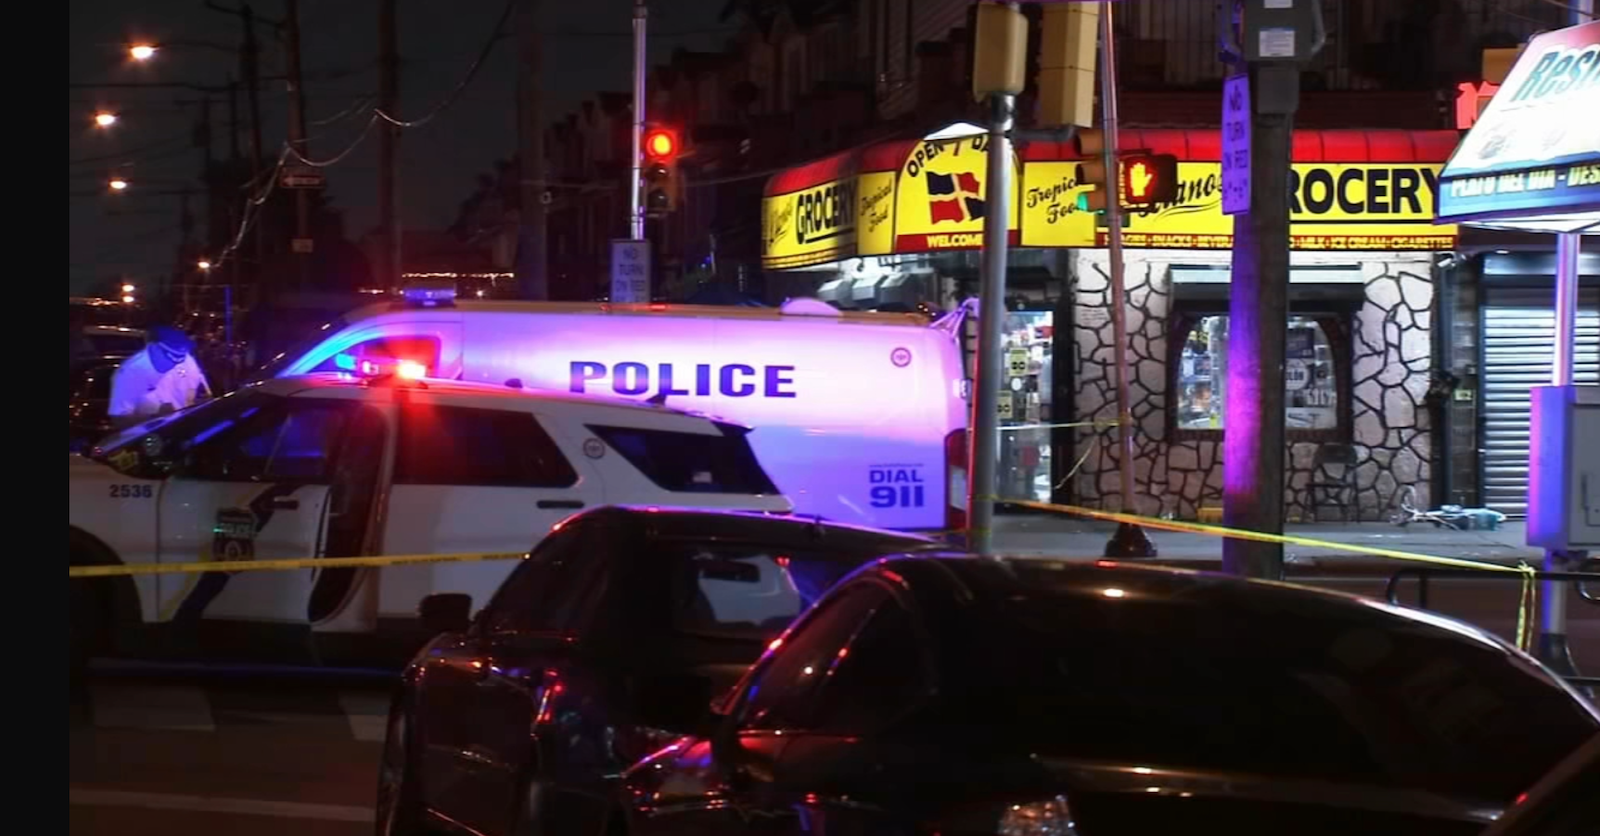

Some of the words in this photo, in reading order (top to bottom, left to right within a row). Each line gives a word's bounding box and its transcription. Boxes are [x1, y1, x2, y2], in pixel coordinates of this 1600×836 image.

[1230, 85, 1243, 111] NO
[1226, 121, 1245, 141] TURN
[907, 140, 945, 177] OPEN
[1234, 149, 1248, 169] RED
[1046, 203, 1077, 225] Foo
[623, 247, 640, 260] NO
[619, 263, 644, 276] TURN
[569, 360, 798, 398] POLICE
[869, 469, 925, 483] DIAL
[869, 485, 925, 509] 911
